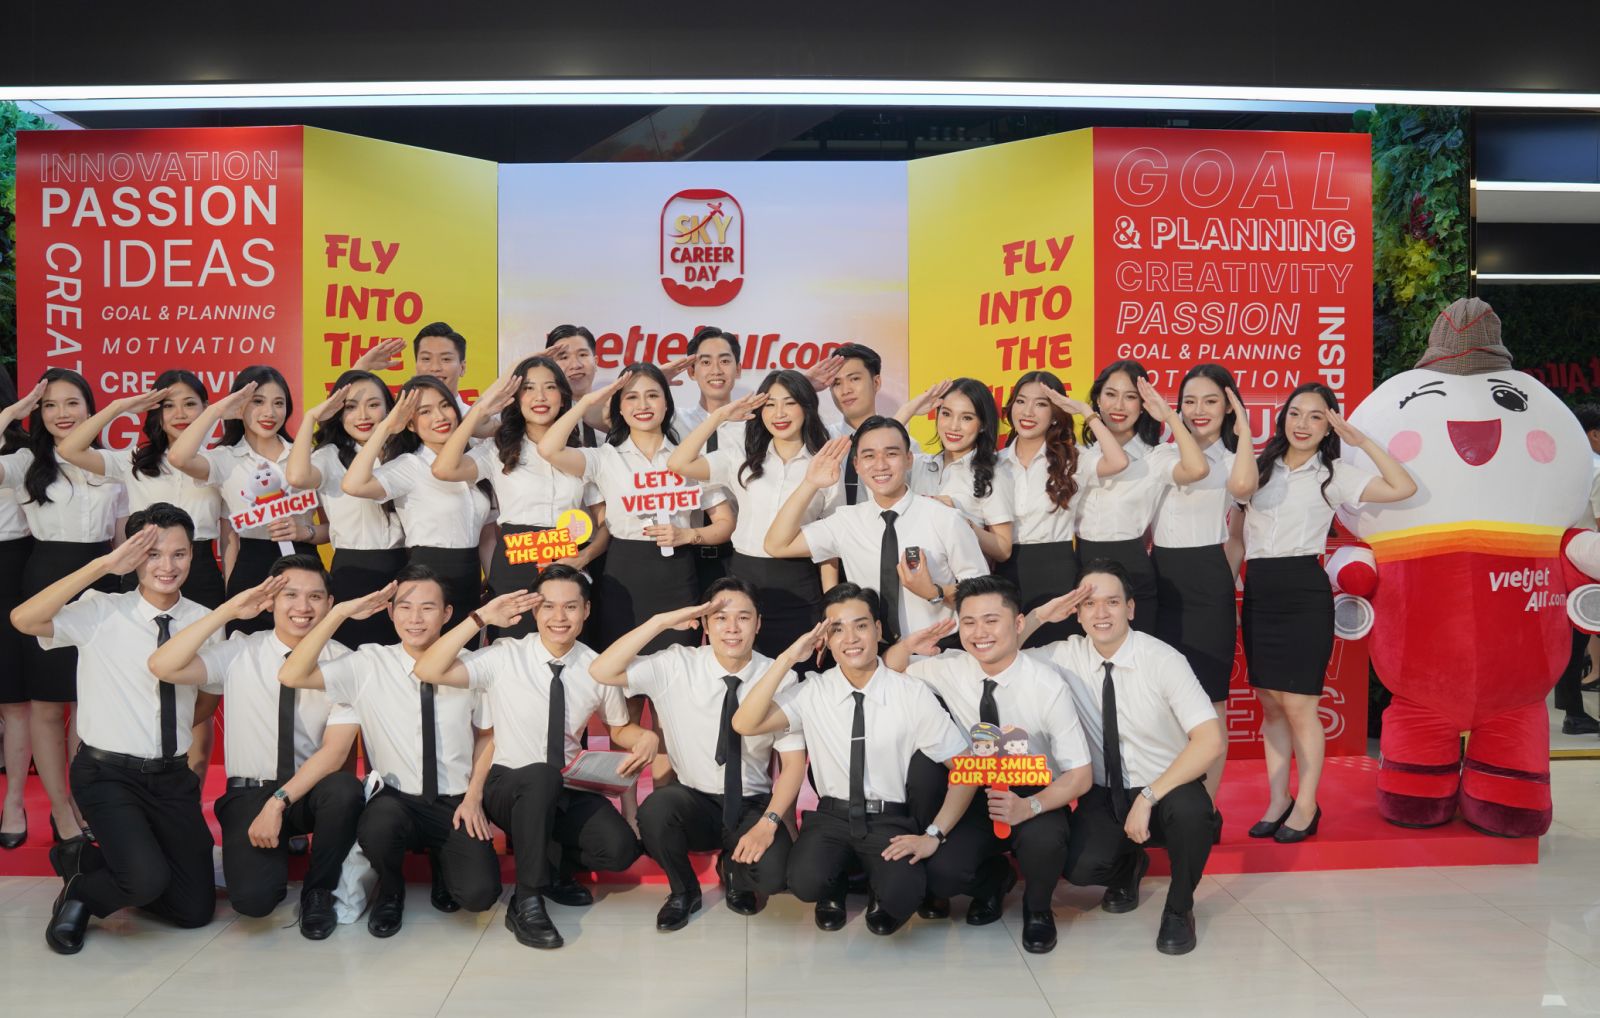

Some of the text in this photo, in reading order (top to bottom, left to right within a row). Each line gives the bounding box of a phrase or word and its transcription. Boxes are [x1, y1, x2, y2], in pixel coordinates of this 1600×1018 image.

[40, 150, 279, 183] INNOVATION
[1113, 146, 1351, 211] GOAL
[41, 184, 278, 228] PASSION
[673, 213, 733, 245] SKY
[1113, 215, 1356, 252] & PLANNING
[102, 237, 276, 288] IDEAS
[323, 233, 401, 275] FLY
[670, 246, 735, 264] CAREER
[1002, 234, 1075, 277] FLY
[684, 265, 720, 283] DAY
[1115, 260, 1354, 294] CREATIVITY
[101, 304, 276, 321] GOAL & PLANNING
[324, 283, 424, 325] INTO
[978, 284, 1073, 327] INTO
[1116, 301, 1301, 336] PASSION
[102, 336, 276, 354] MOTIVATION
[995, 333, 1073, 372] THE
[1117, 343, 1301, 361] GOAL & PLANNING
[633, 470, 684, 489] LET'S
[232, 491, 316, 530] FLY HIGH
[621, 489, 700, 513] VIETJET
[504, 529, 570, 549] WE ARE
[506, 544, 578, 563] THE ONE
[950, 771, 1051, 784] OUR PASSION
[953, 757, 1046, 770] YOUR SMILE
